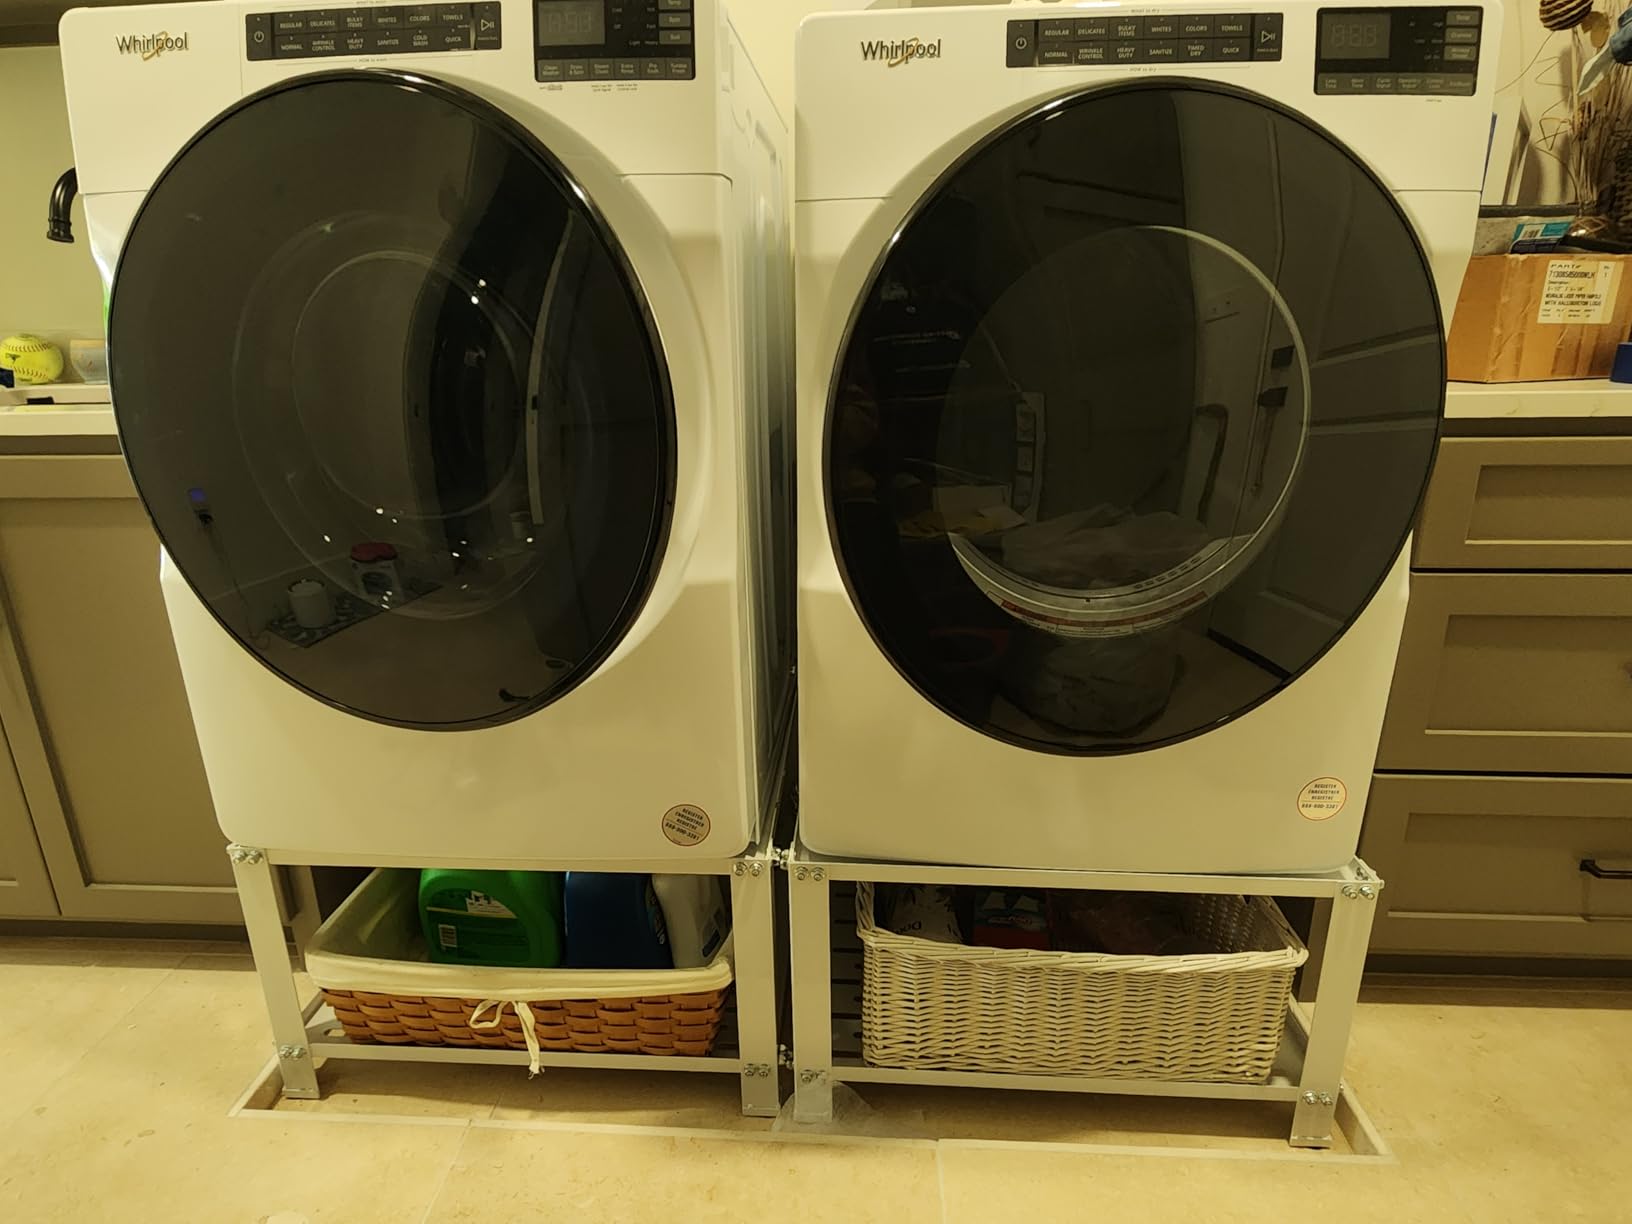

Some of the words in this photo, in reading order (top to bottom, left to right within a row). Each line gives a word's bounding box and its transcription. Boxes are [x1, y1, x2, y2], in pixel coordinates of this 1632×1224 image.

[115, 31, 189, 58] Whirlpool
[860, 38, 942, 65] Whirlpool
[1222, 46, 1240, 54] QUICK
